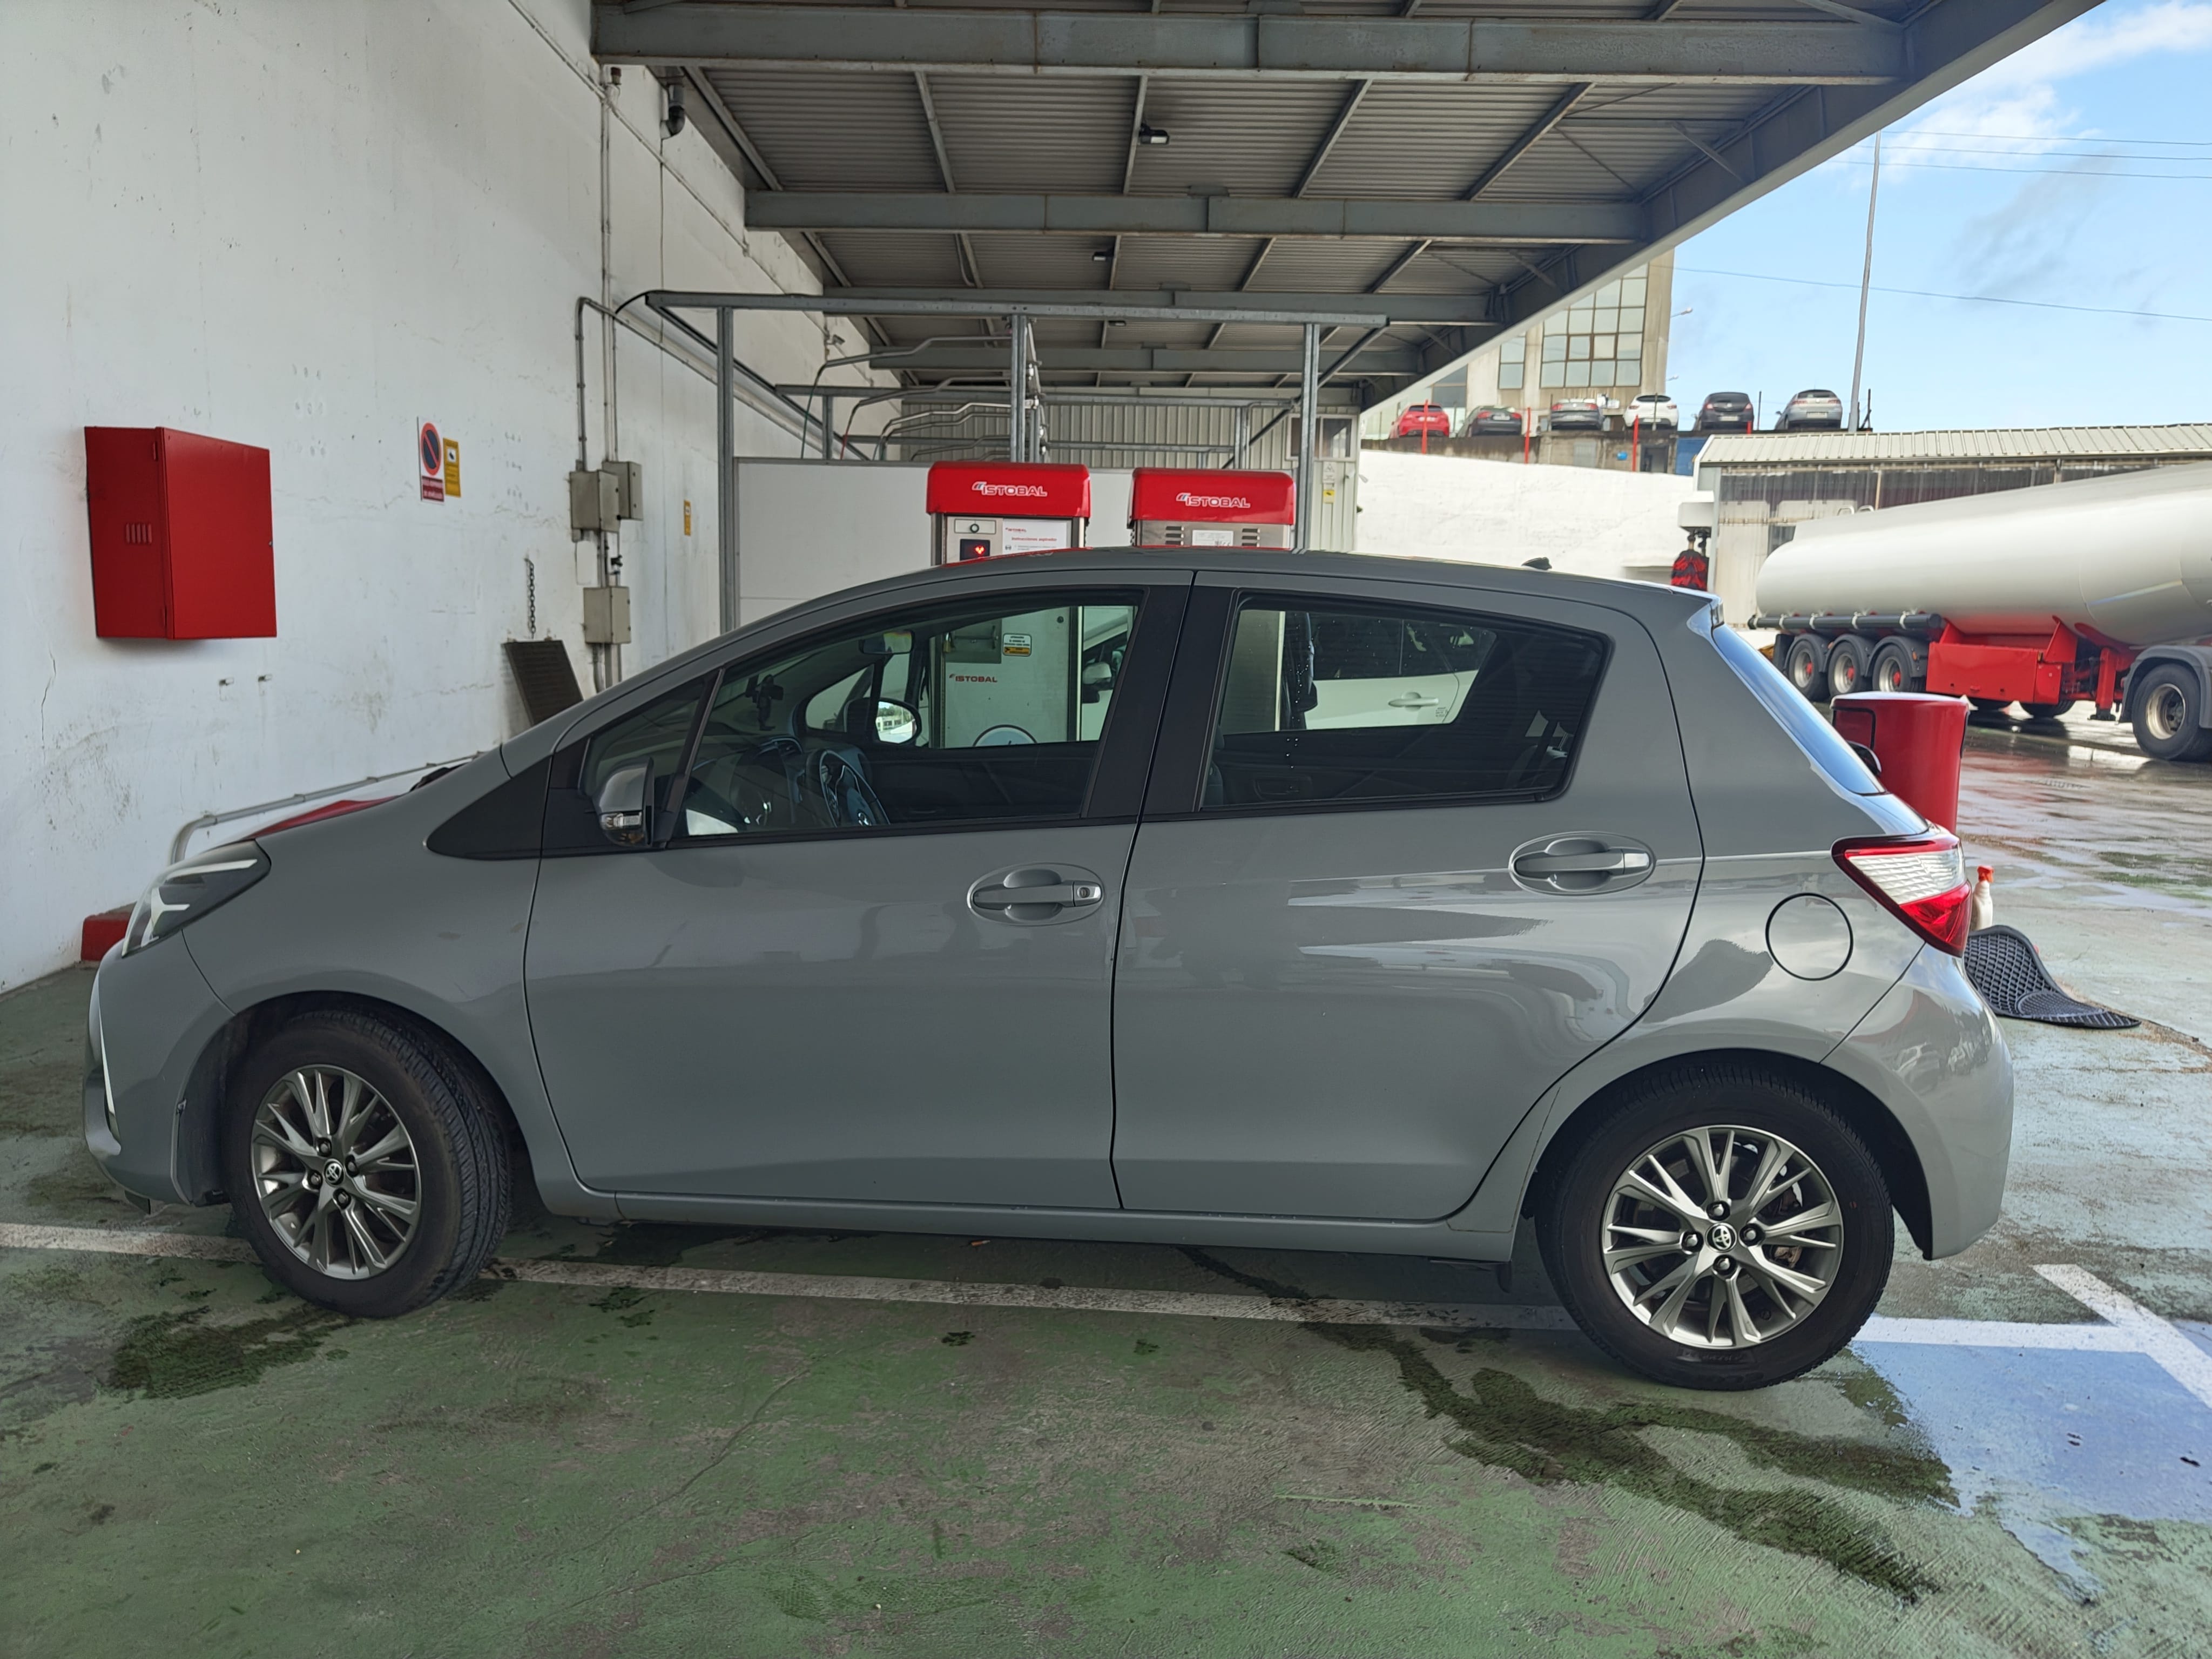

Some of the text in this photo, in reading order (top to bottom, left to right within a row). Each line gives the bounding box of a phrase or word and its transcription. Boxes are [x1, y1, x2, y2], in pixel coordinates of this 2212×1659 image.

[981, 484, 1048, 497] ISTOBAL
[1185, 495, 1251, 508] ISTOBAL
[955, 675, 998, 683] ISTOBAL
